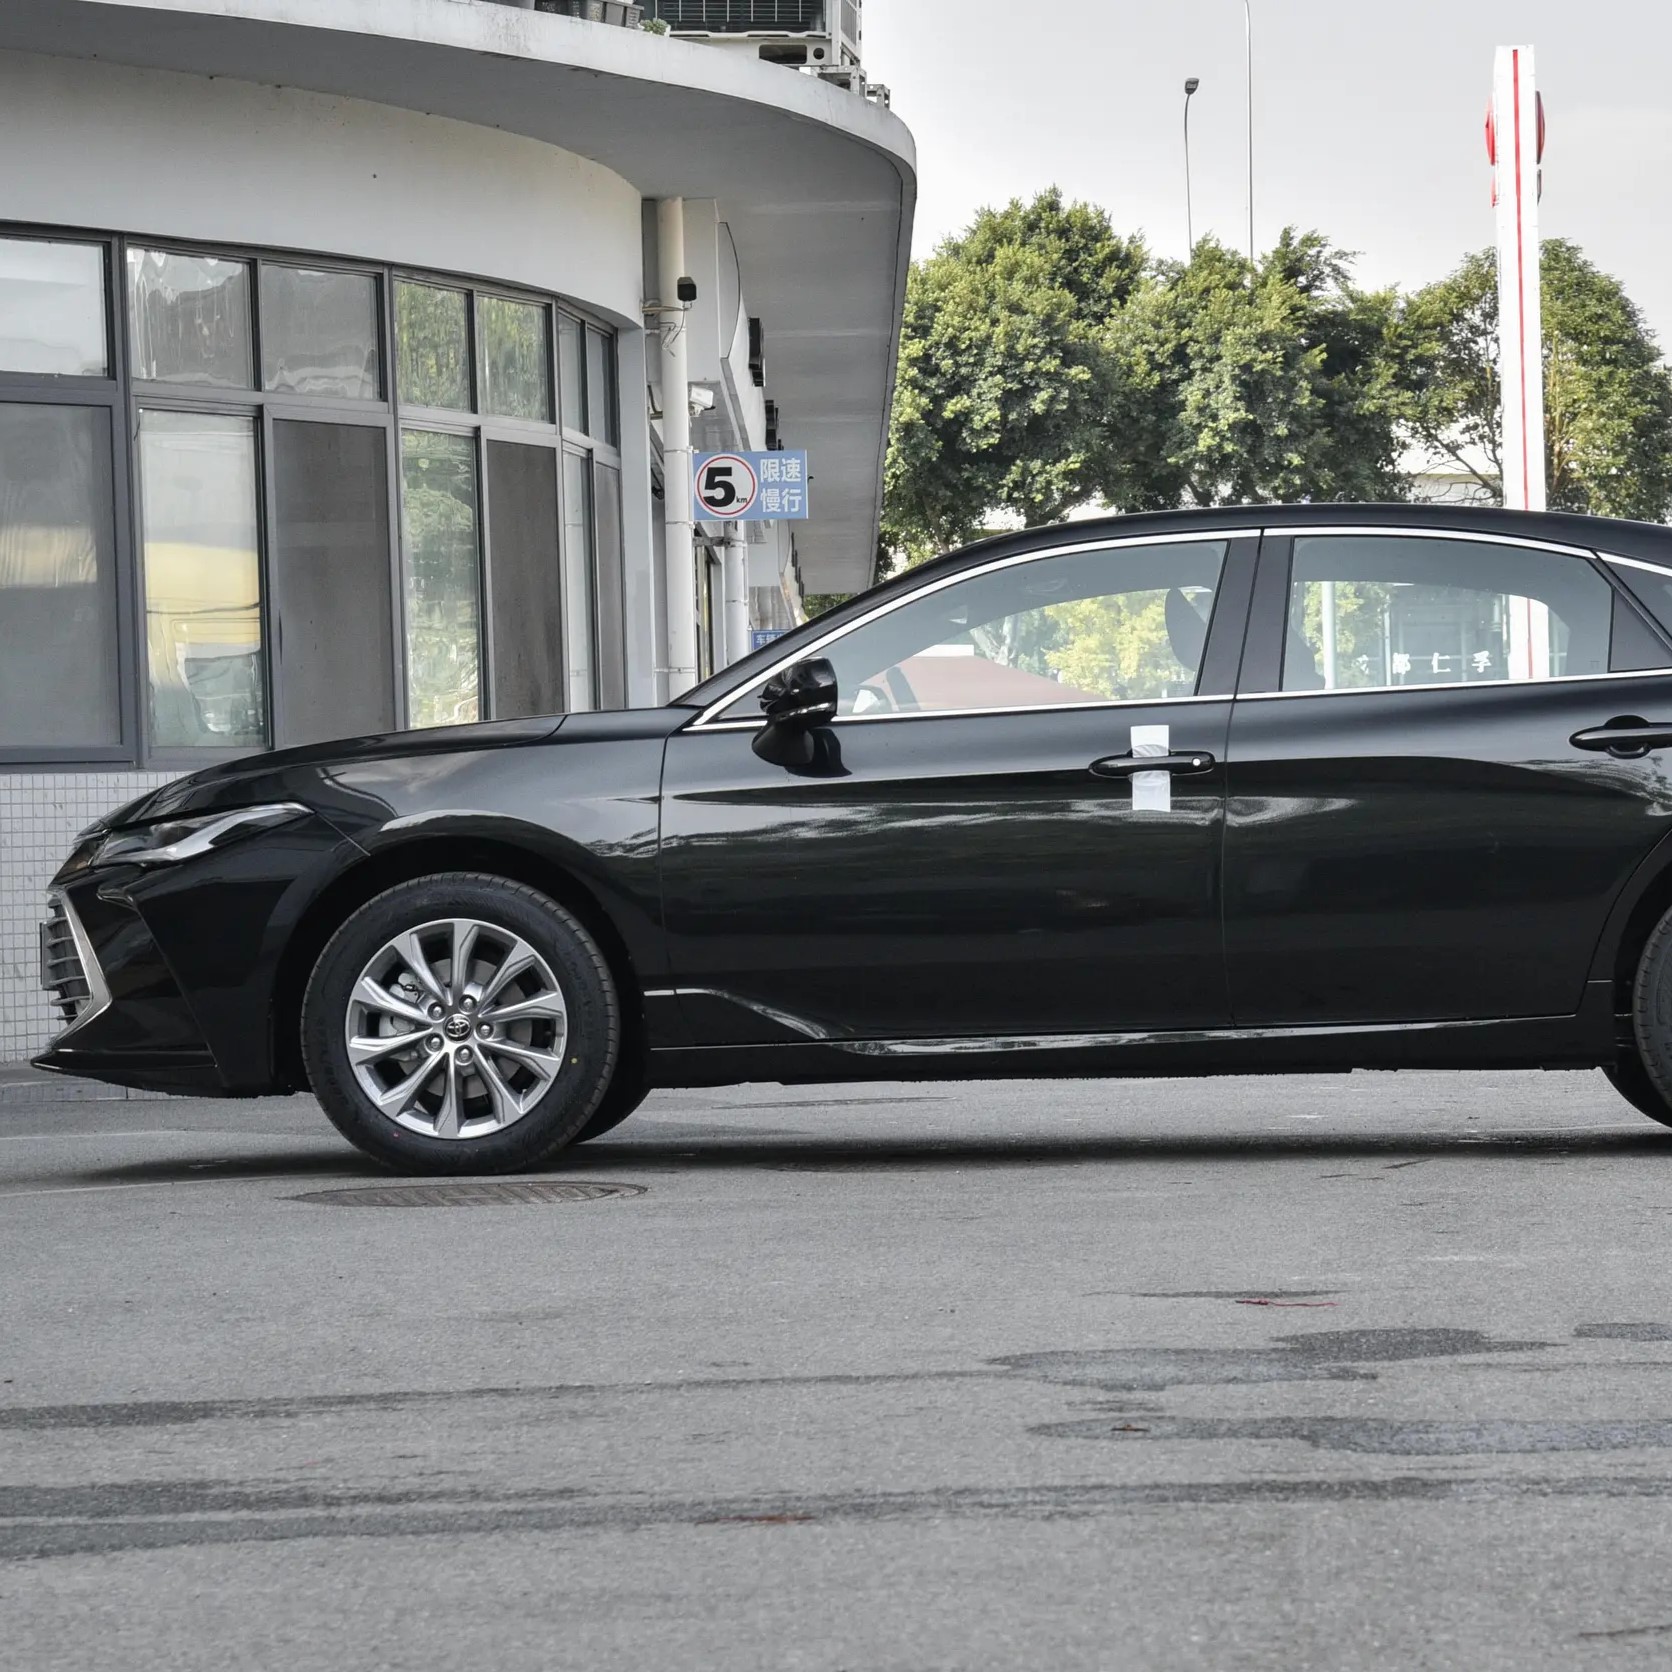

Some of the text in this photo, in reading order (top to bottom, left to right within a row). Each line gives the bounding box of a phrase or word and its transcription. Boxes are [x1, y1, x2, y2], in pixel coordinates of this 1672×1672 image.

[760, 458, 802, 482] 限速
[703, 466, 736, 508] 5
[760, 488, 802, 513] 慢行
